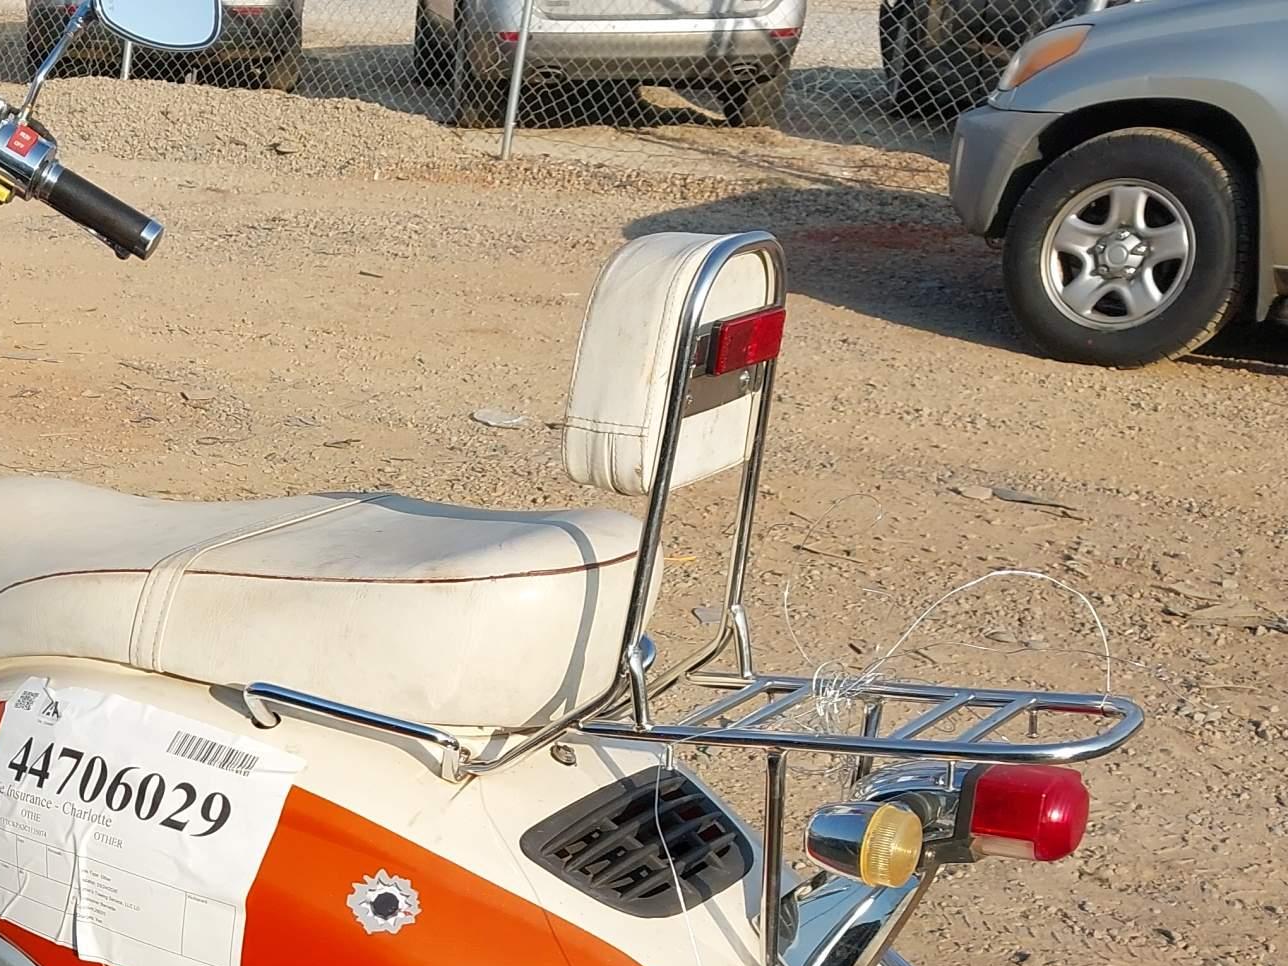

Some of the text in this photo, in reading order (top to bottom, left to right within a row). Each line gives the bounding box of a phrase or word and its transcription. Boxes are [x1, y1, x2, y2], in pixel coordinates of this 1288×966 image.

[6, 784, 54, 810] Insurance
[62, 801, 113, 828] Charlotte
[8, 737, 232, 837] 44706029
[20, 808, 42, 823] OTHE
[93, 831, 124, 849] OTHER
